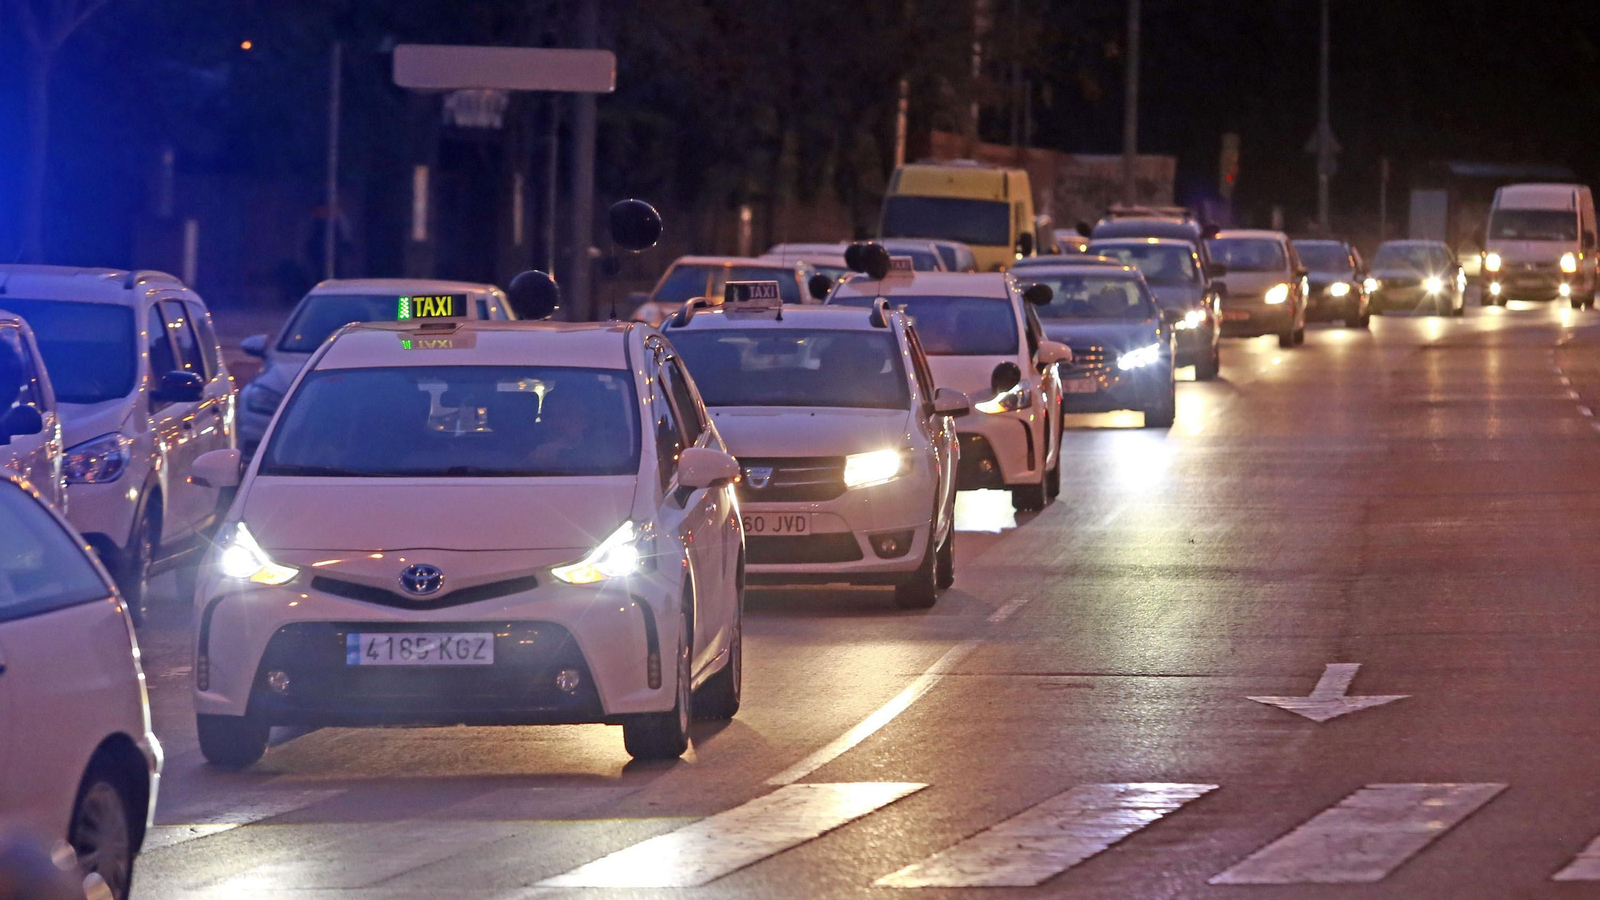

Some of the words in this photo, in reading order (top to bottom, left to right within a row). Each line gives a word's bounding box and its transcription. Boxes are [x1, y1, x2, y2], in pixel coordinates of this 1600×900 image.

[749, 285, 775, 298] TAXI
[413, 296, 452, 317] TAXI
[772, 515, 806, 533] JVD
[366, 636, 429, 660] 4185
[439, 636, 487, 660] KGZ
